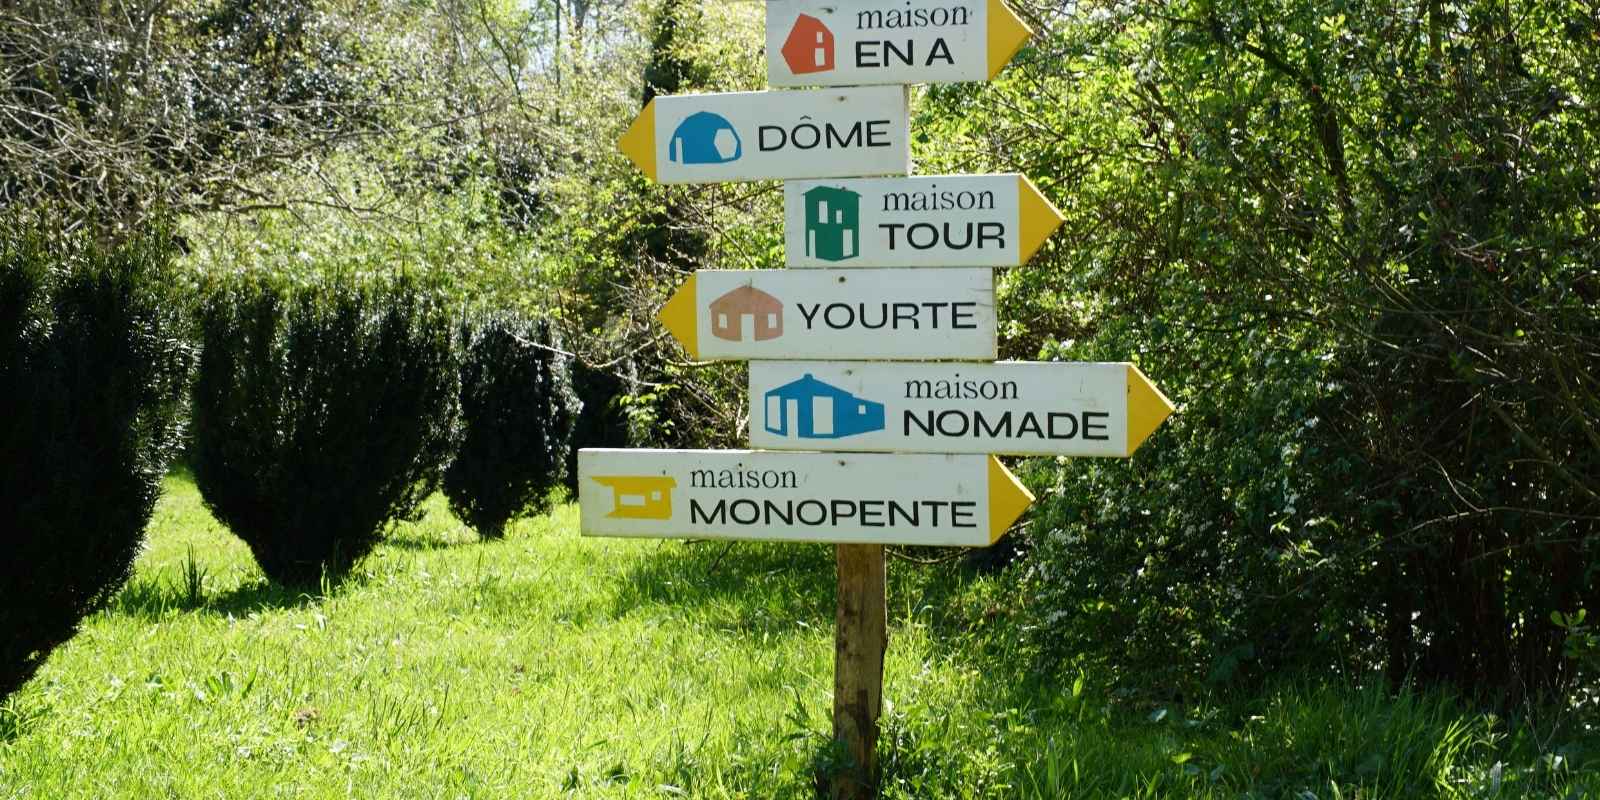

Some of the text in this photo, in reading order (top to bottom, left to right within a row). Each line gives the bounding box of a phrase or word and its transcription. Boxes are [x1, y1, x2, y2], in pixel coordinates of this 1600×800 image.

[857, 1, 969, 30] maison
[855, 37, 955, 69] EN A
[758, 115, 892, 152] DÔME
[882, 184, 995, 212] maison
[878, 221, 1006, 251] TOUR
[796, 301, 978, 330] YOURTE
[904, 374, 1018, 401] maison
[903, 409, 1110, 441] NOMADE
[689, 463, 798, 489] maison
[689, 498, 977, 528] MONOPENTE
